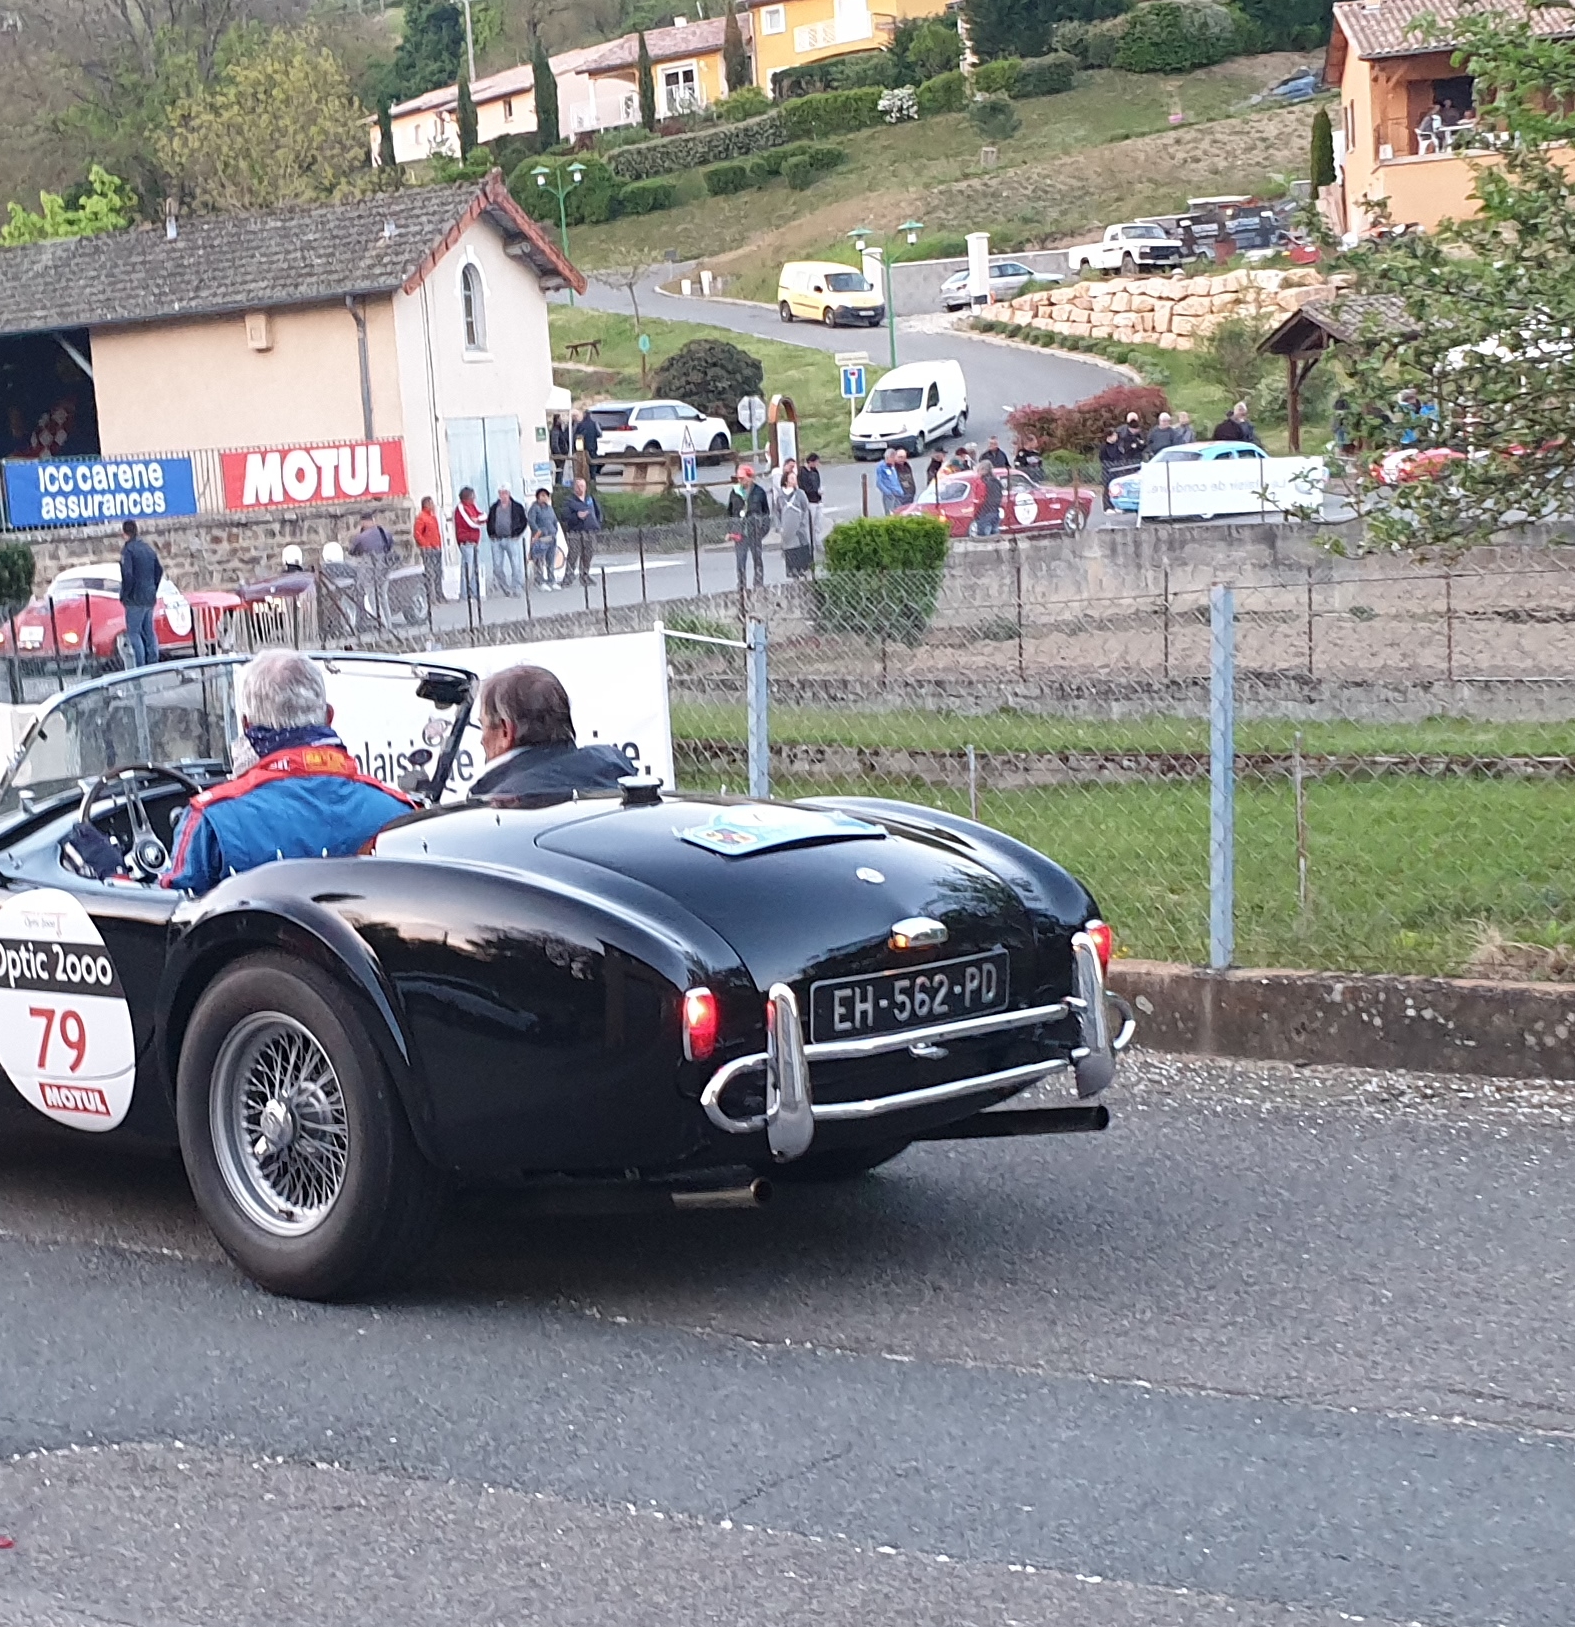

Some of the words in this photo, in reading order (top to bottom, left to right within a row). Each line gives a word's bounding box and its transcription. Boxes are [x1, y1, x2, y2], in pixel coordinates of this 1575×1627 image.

[38, 465, 74, 493] ICC
[76, 462, 164, 491] carene
[242, 444, 391, 506] MOTUL
[41, 491, 166, 520] assurances
[52, 943, 114, 987] 2000
[832, 962, 998, 1032] EH-562-PD
[29, 1005, 87, 1074] 79
[46, 1084, 108, 1113] MOTUL
